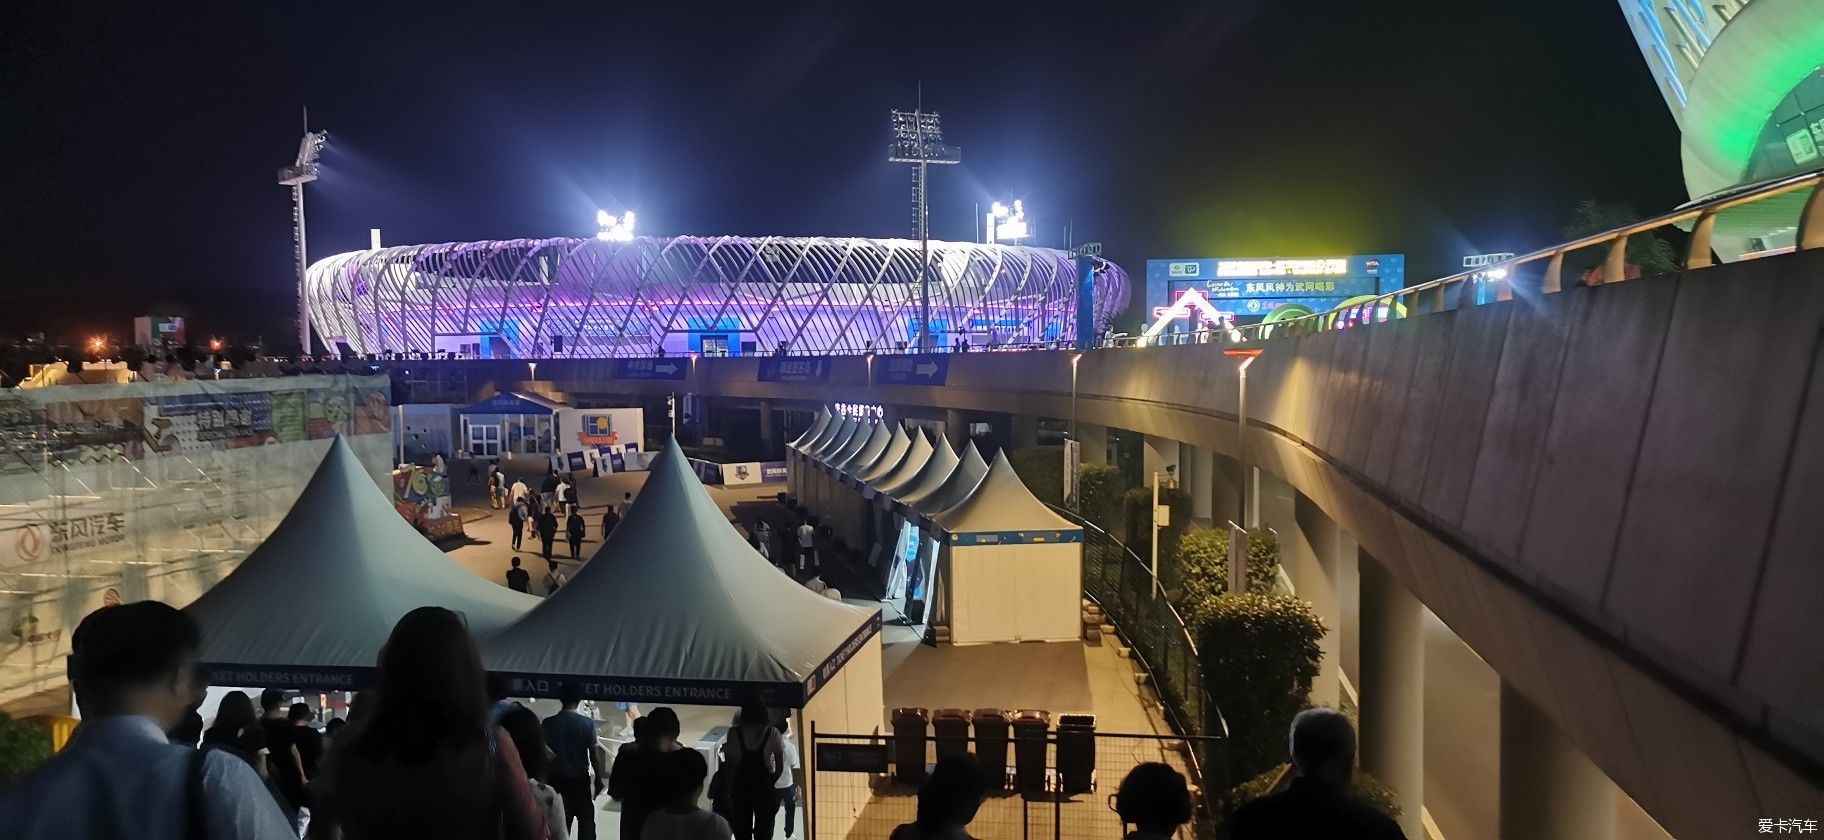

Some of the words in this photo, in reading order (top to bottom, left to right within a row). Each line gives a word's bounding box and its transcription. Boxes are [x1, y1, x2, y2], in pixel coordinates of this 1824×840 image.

[1245, 281, 1335, 293] 东风风神为武网喝彩
[49, 512, 125, 543] 东风汽车
[236, 671, 290, 684] HOLDERS
[292, 672, 354, 686] ENTRANCE
[603, 683, 661, 697] HOLDERS
[665, 686, 731, 700] ENTRANCE
